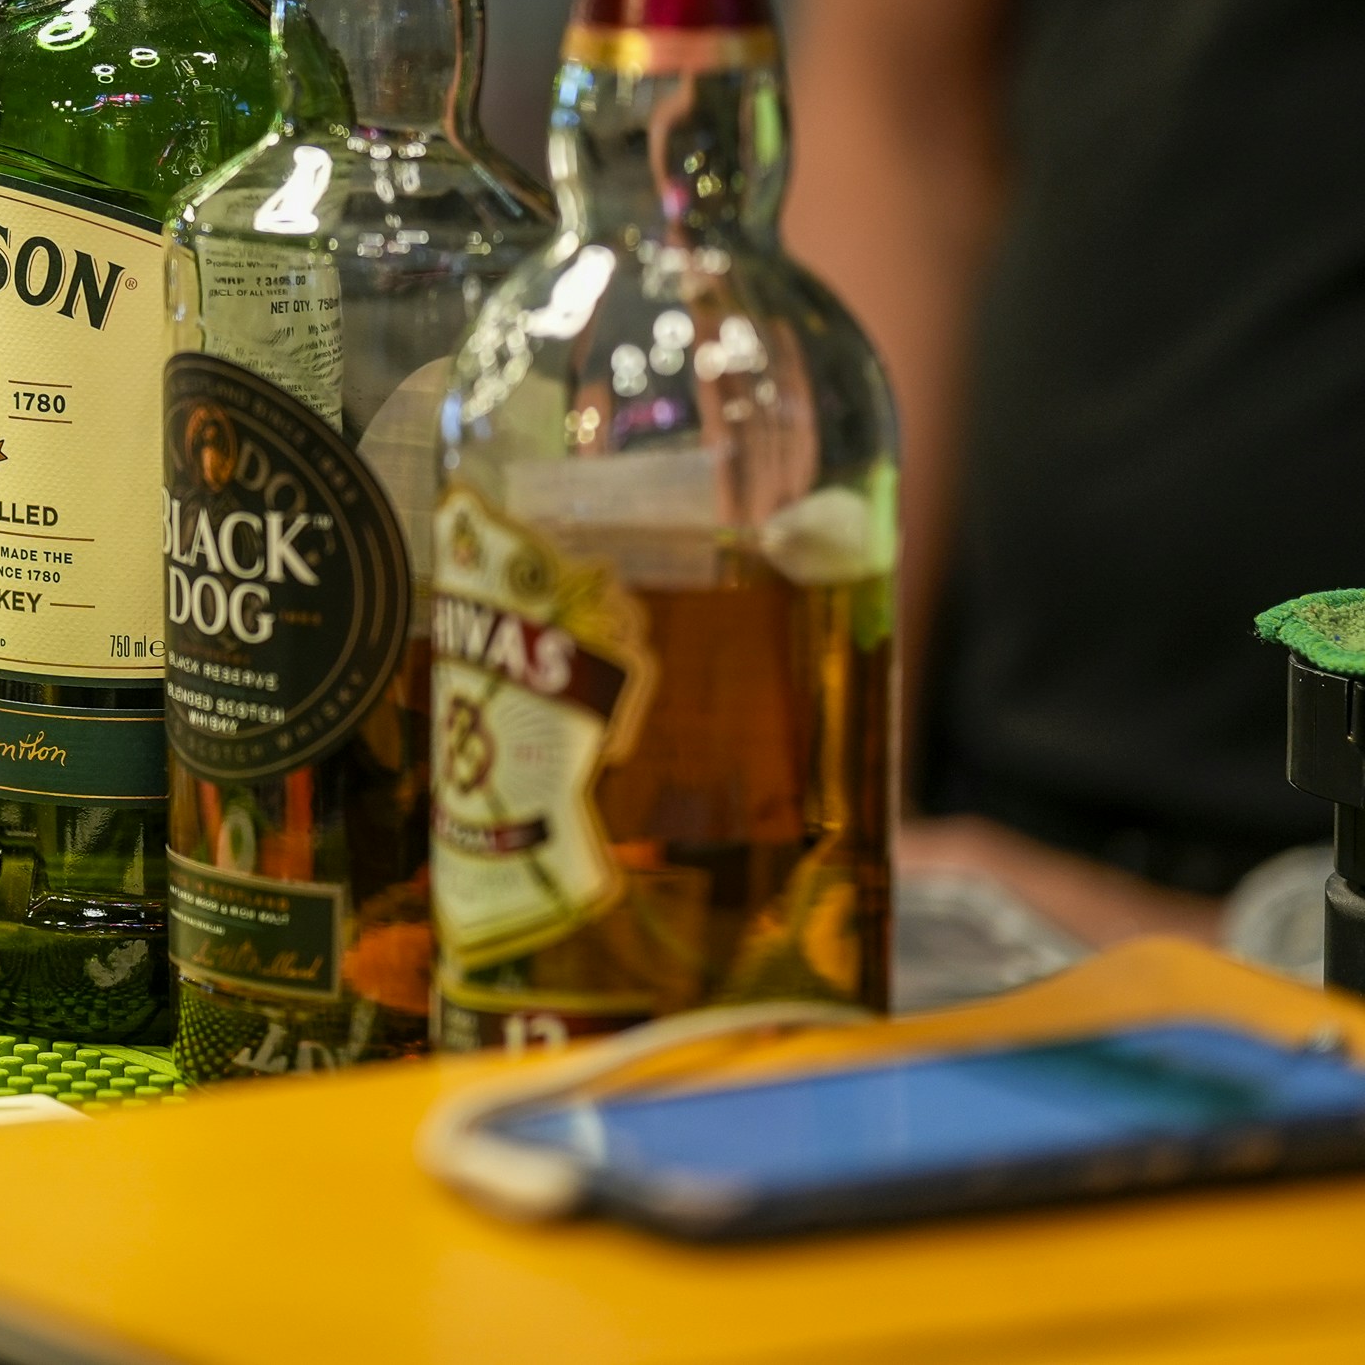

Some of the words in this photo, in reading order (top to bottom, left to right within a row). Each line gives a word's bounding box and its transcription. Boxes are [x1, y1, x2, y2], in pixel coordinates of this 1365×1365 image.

[270, 300, 289, 314] NET
[293, 300, 313, 313] QTY.
[13, 391, 66, 414] 1780
[0, 546, 38, 562] MADE
[43, 551, 73, 565] THE
[27, 569, 61, 584] 1780
[168, 565, 276, 645] DOG
[109, 635, 130, 658] 750
[202, 661, 279, 692] RESERVE
